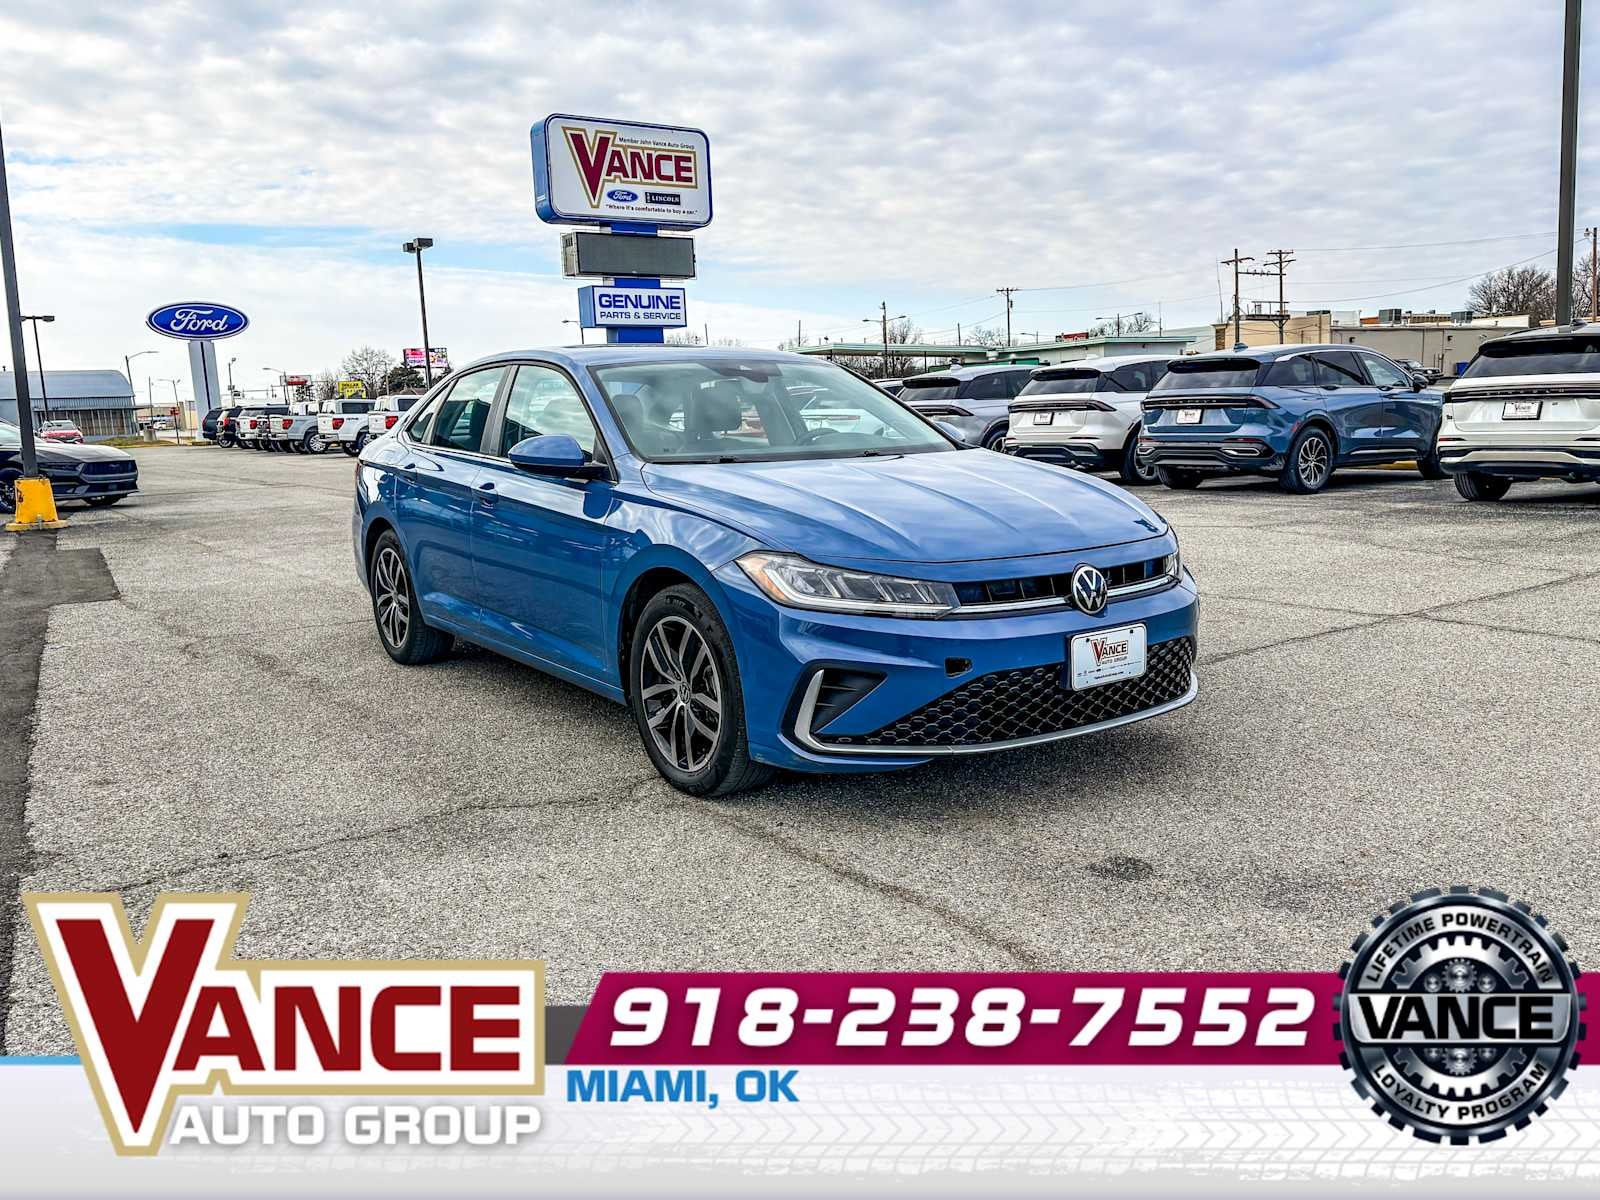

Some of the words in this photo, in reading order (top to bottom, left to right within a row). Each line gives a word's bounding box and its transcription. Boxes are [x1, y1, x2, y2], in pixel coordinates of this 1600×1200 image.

[569, 133, 693, 200] VANCE
[612, 191, 633, 201] Ford
[599, 294, 681, 309] GENUINE
[170, 308, 228, 331] Ford
[600, 311, 631, 320] PARTS
[633, 312, 641, 320] &
[643, 311, 681, 320] SERVICE
[1091, 640, 1128, 664] VANCE
